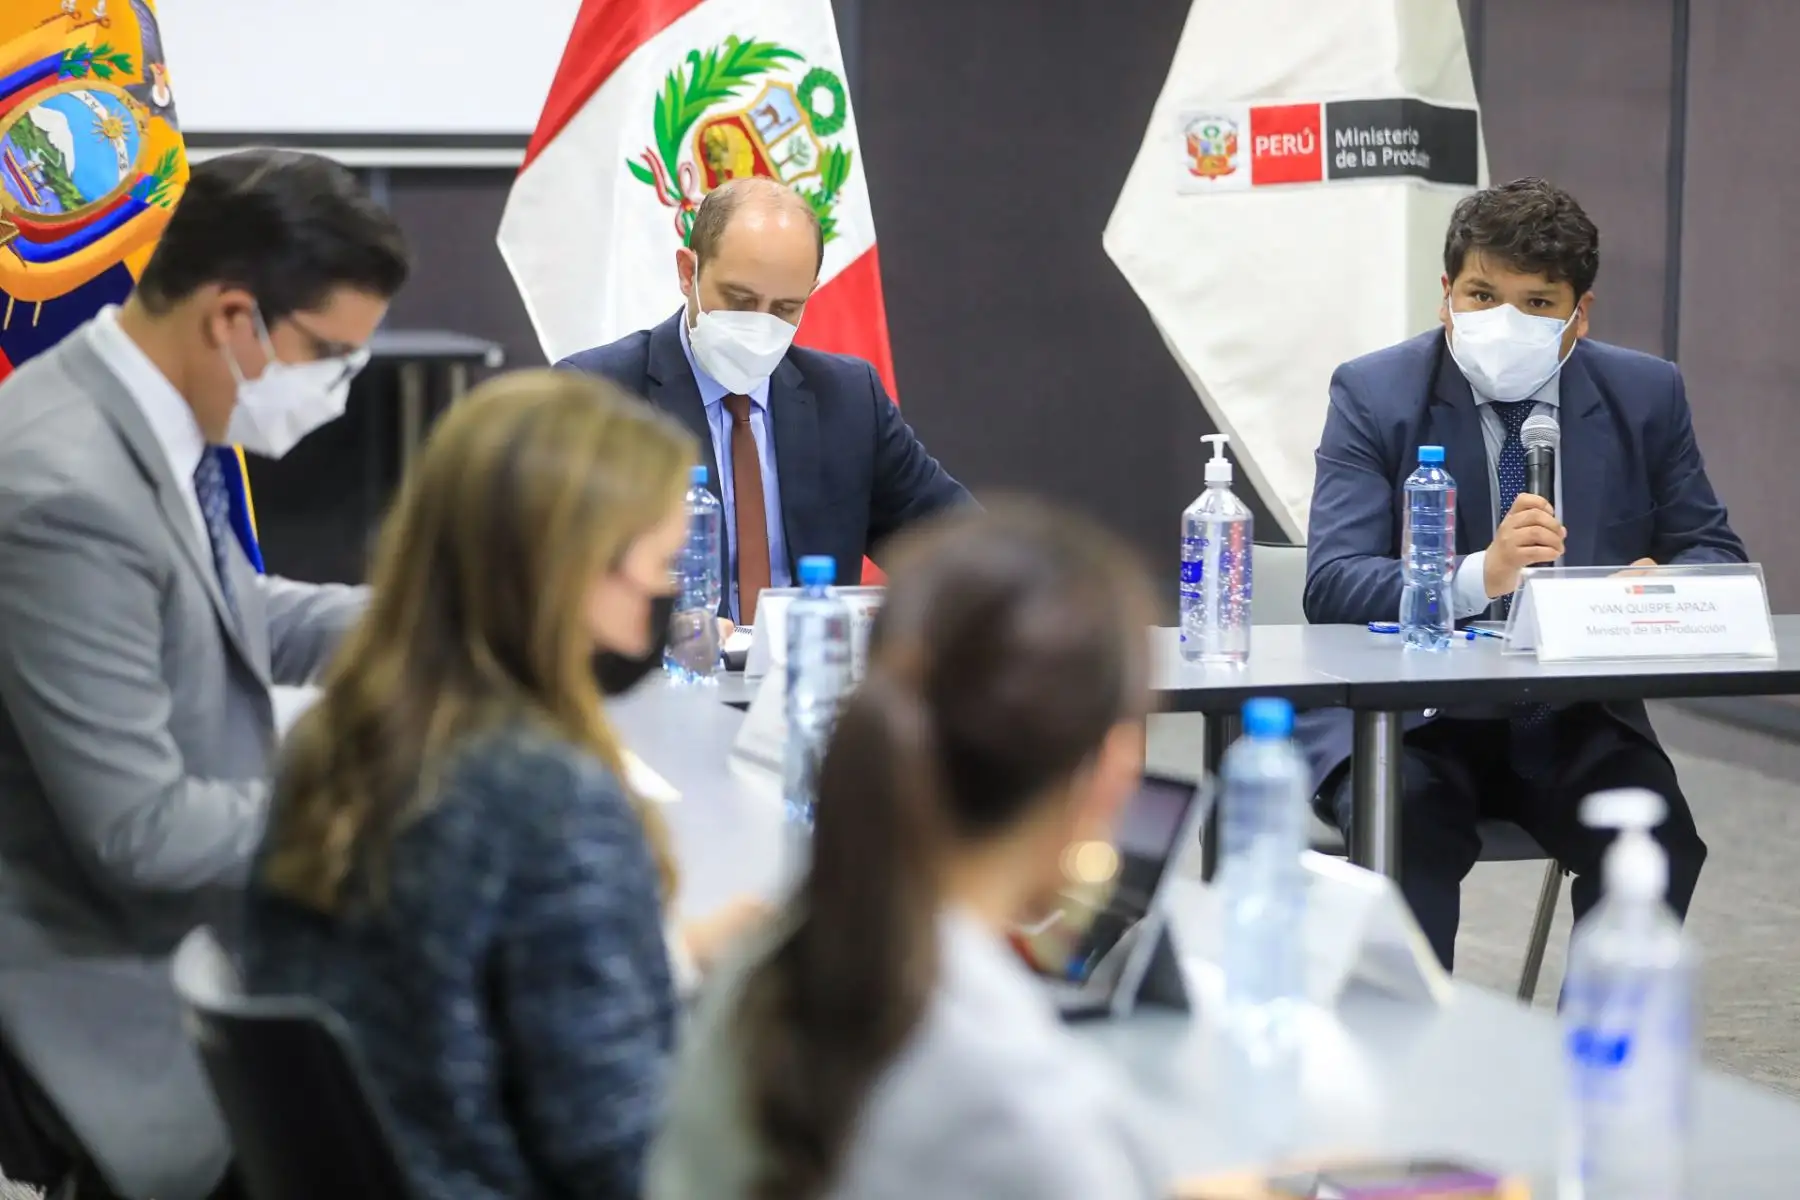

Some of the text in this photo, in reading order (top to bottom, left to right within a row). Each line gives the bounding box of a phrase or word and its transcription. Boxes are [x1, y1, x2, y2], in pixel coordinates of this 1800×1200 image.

[1256, 126, 1315, 157] PERÚ
[1335, 125, 1420, 148] Ministerio
[1336, 149, 1357, 169] de
[1361, 147, 1377, 167] la
[1627, 602, 1673, 614] QUISPE
[1675, 601, 1718, 612] APAZA
[1586, 622, 1727, 636] Ministro de la Producción
